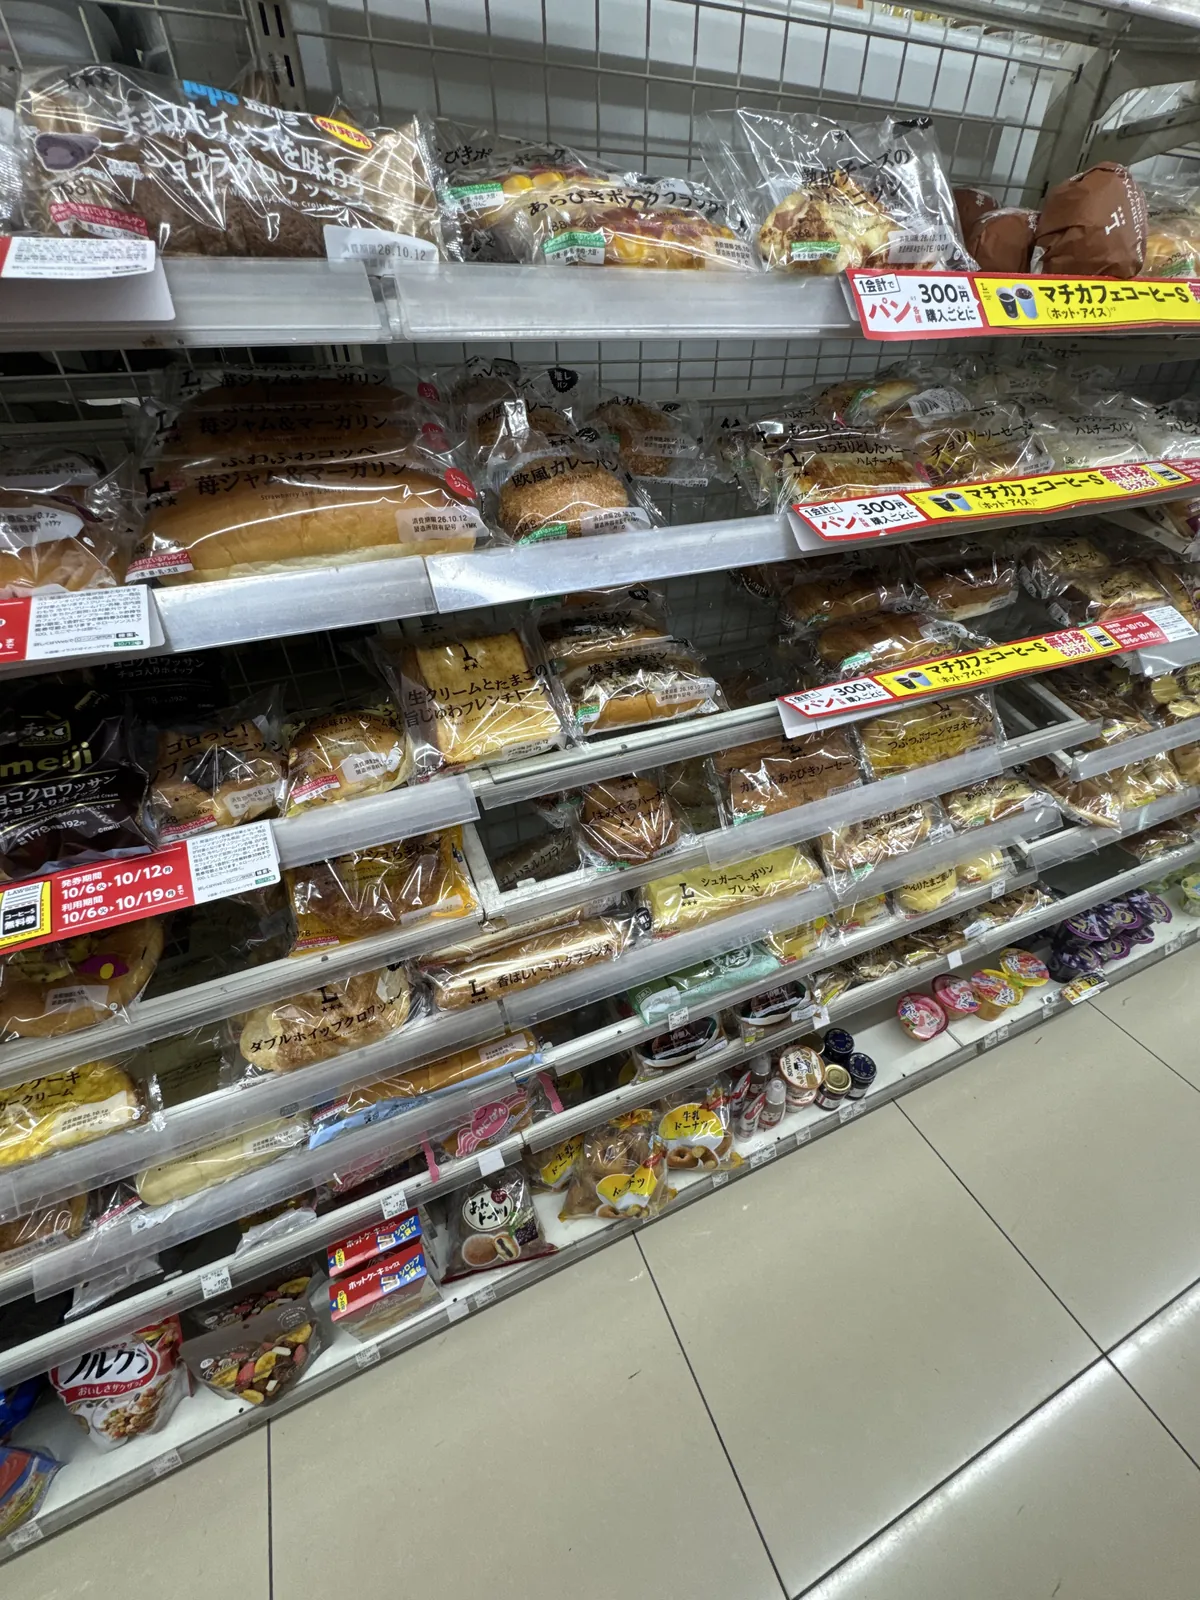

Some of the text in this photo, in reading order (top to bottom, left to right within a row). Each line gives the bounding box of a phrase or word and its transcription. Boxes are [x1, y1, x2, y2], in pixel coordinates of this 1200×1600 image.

[802, 149, 910, 190] 熟成チーズの
[859, 276, 895, 294] 1会計で
[918, 283, 970, 305] 300円
[1038, 283, 1190, 304] マチカフェコーヒーS
[868, 297, 911, 324] パン
[925, 307, 977, 323] 購入ごとに
[200, 415, 388, 436] 苺ジャム&マーガリン
[195, 462, 408, 495] 苺ジャム&マーガリン
[512, 455, 619, 488] 欧風カレーパン
[140, 467, 170, 498] L
[965, 473, 1105, 500] マチカフェコーヒーS
[857, 500, 908, 516] 300円
[869, 510, 918, 526] 購入ごとに
[821, 515, 856, 531] パン
[925, 642, 1048, 675] マチカフェコーヒーS
[408, 664, 548, 707] 生クリームとたまごの
[833, 682, 876, 698] 300円
[404, 682, 551, 728] 旨じゅわフレンチトース
[804, 697, 836, 711] パン
[0, 741, 93, 778] meiji
[60, 872, 103, 889] 発券期間
[61, 895, 103, 912] 利用期間
[5, 908, 35, 921] コーヒーS
[497, 944, 613, 988] 香ばしいミルクフランス
[469, 980, 486, 997] L
[474, 1106, 508, 1137] かにぱん
[674, 1120, 708, 1131] ドーナツ
[683, 1110, 699, 1122] 牛乳
[470, 1197, 490, 1215] あん
[346, 1221, 396, 1248] ホットケーキミックス
[395, 1216, 416, 1236] シロップ
[348, 1259, 402, 1291] ホットケーキミックス
[399, 1255, 421, 1276] シロップ
